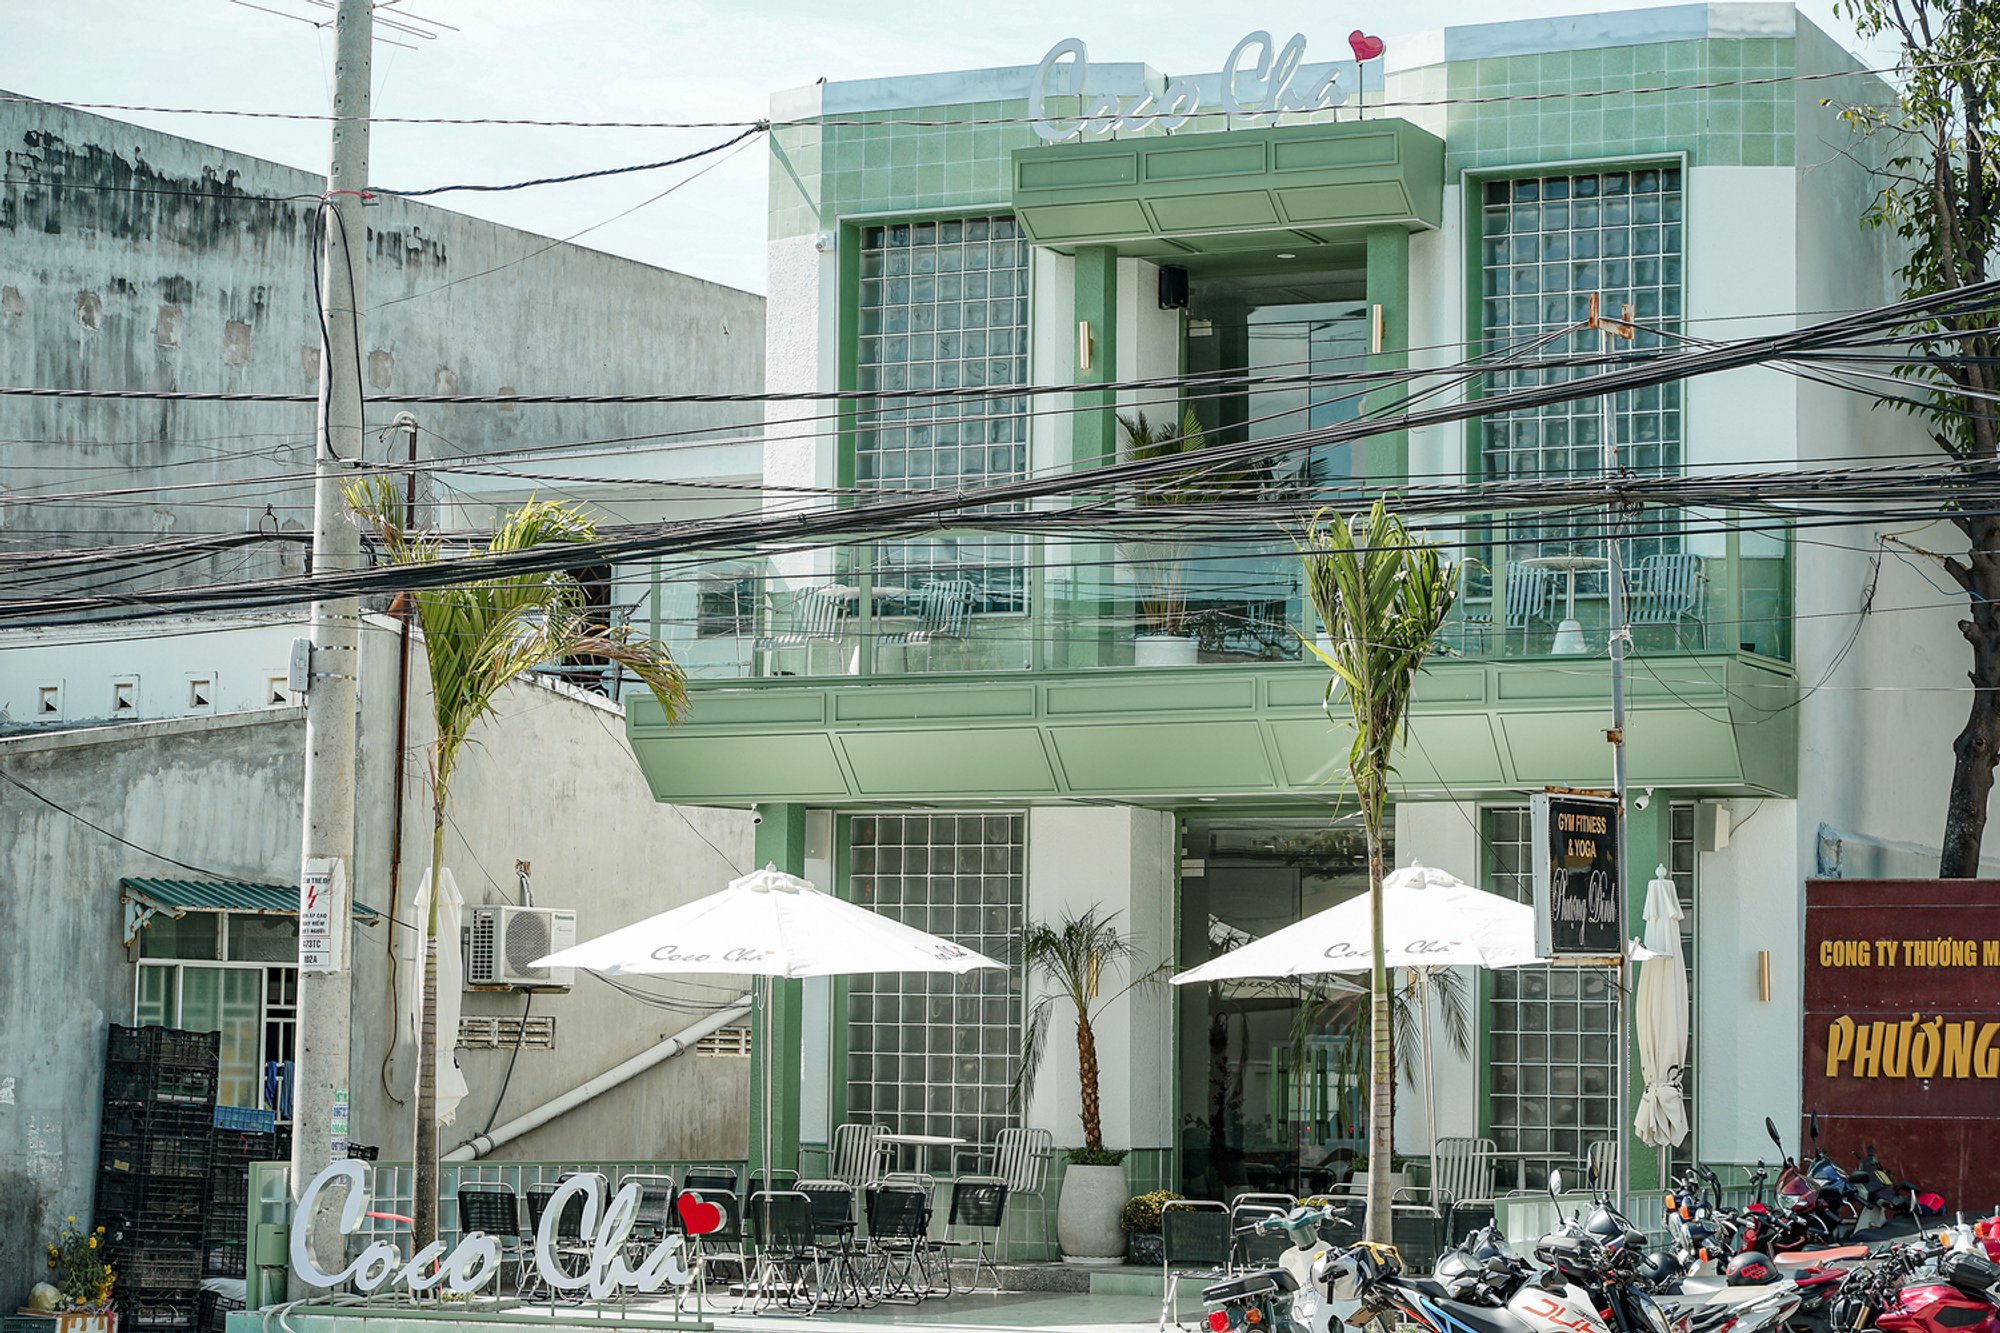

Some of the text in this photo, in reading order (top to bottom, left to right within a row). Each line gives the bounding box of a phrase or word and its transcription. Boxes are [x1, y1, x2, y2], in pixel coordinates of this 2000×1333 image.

[1028, 37, 1200, 141] Coco
[1558, 813, 1607, 835] GYM FITNESS
[1568, 840, 1597, 858] & YOGA
[650, 945, 762, 962] Coco Cha
[1875, 940, 1899, 967] TY
[1902, 936, 1977, 967] THƯƠNG
[1983, 940, 2000, 967] M
[290, 1159, 697, 1300] Coco Cha
